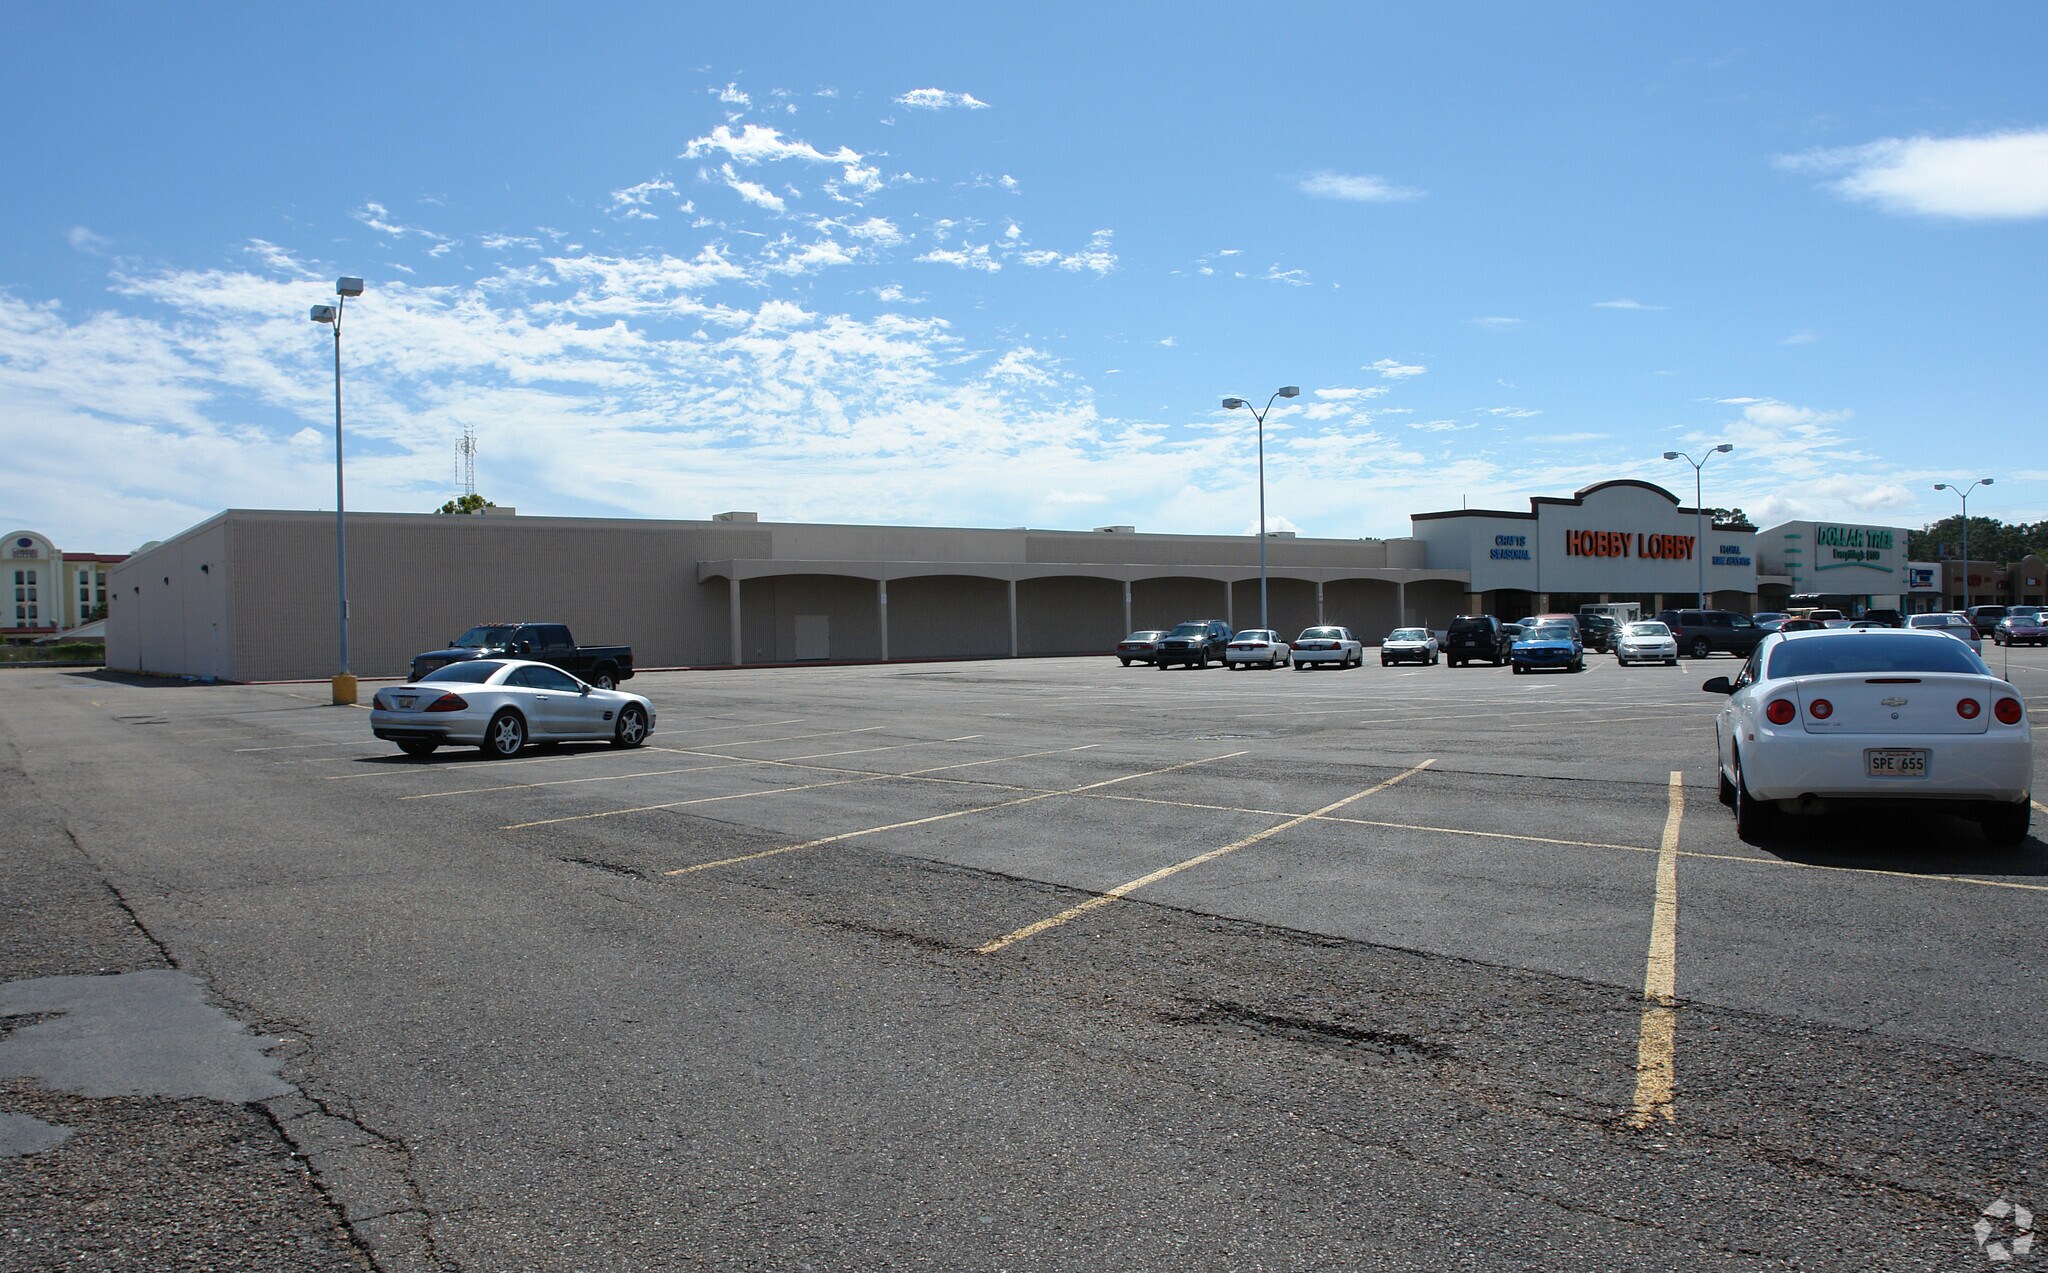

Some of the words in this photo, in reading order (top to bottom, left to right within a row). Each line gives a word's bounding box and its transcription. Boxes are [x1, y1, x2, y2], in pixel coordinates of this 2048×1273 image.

[1495, 534, 1527, 547] CRAFTS
[1817, 526, 1865, 548] DOLLAR
[1866, 530, 1893, 549] TREE
[1566, 529, 1633, 558] HOBBY
[1638, 533, 1696, 560] LOBBY
[1490, 548, 1532, 561] SEASONAL
[1873, 757, 1894, 769] SPE
[1902, 757, 1923, 769] 655
